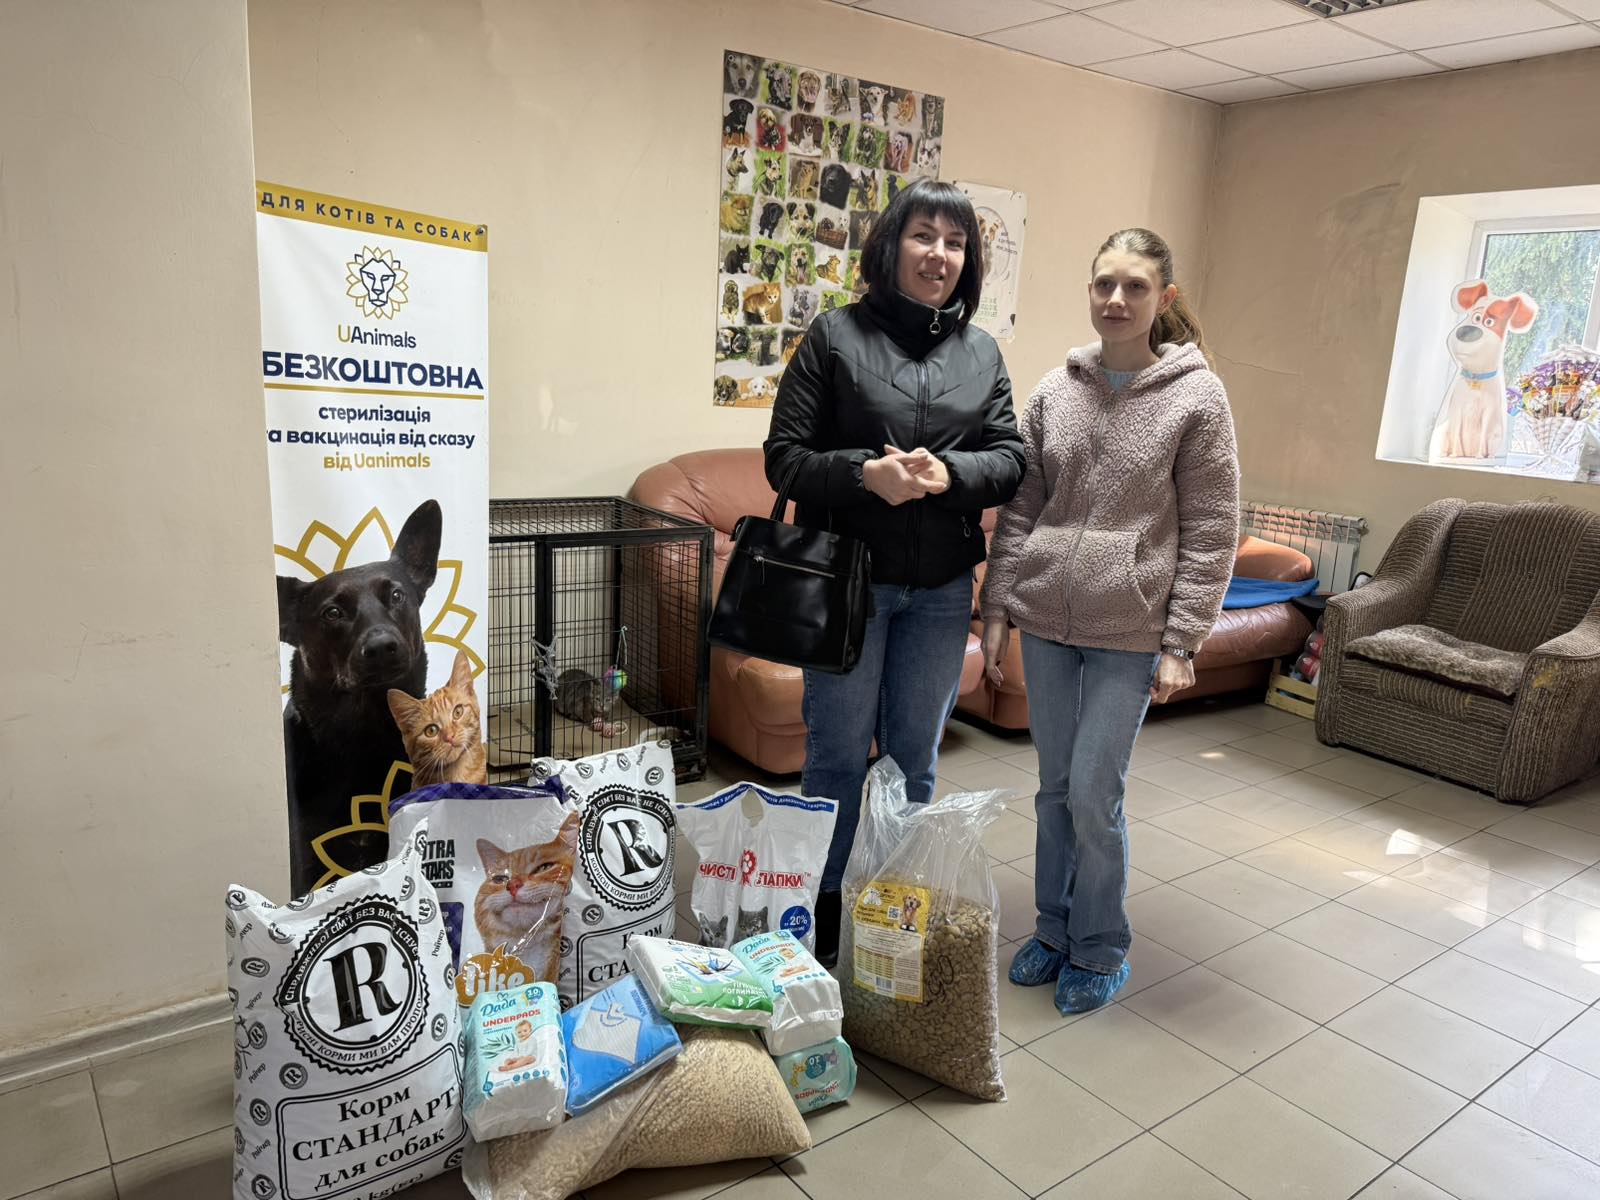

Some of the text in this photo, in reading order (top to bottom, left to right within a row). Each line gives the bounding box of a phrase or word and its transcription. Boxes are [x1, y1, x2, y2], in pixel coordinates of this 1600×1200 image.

[261, 192, 472, 243] ДЛЯ КОТІВ ТА СОБАК
[337, 324, 417, 349] UAnimals
[262, 351, 484, 390] БЕЗКОШТОВНА
[318, 405, 431, 425] стерилізація
[266, 429, 475, 449] а вакцинація від сказу
[324, 452, 431, 472] від Uanimals
[700, 863, 736, 881] ЧИСТІ
[756, 872, 803, 887] ЛАПКИ
[355, 907, 375, 920] БЕЗ
[790, 915, 808, 926] 20%
[323, 942, 402, 1032] R
[480, 998, 517, 1018] Dada
[482, 1008, 541, 1028] UNDERPADS
[318, 1044, 356, 1062] КОРМИ
[359, 1050, 379, 1061] МИ
[380, 1034, 402, 1055] ВАМ
[338, 1086, 411, 1122] Корм
[292, 1087, 455, 1161] СТАНДАРТ
[314, 1128, 445, 1191] для собак
